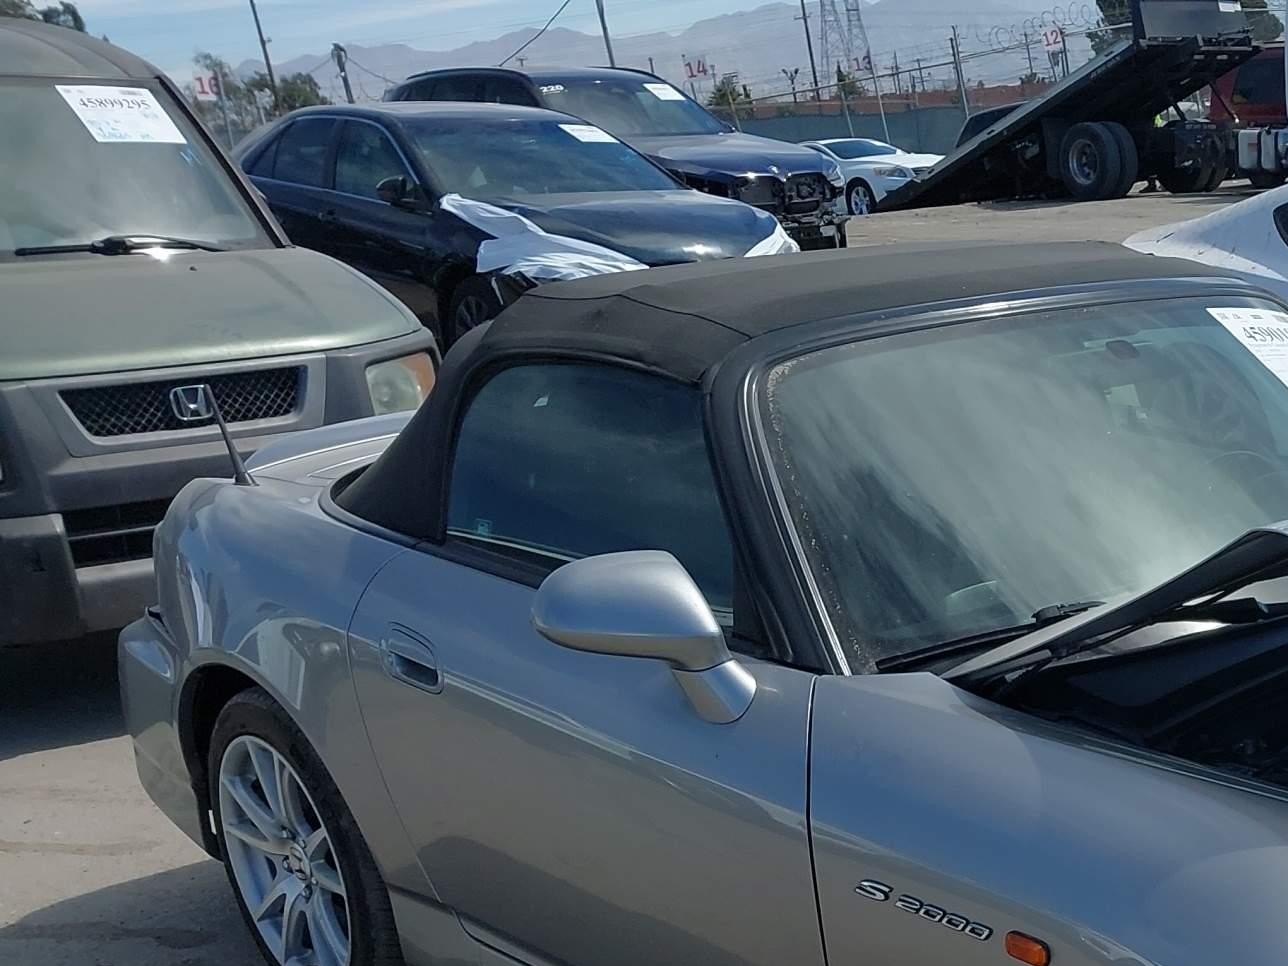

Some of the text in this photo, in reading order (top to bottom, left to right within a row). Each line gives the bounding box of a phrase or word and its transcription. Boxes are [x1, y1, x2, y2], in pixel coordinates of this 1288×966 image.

[1042, 30, 1062, 47] 12
[684, 60, 708, 79] 14
[852, 56, 872, 71] 13
[79, 98, 151, 111] 45899295
